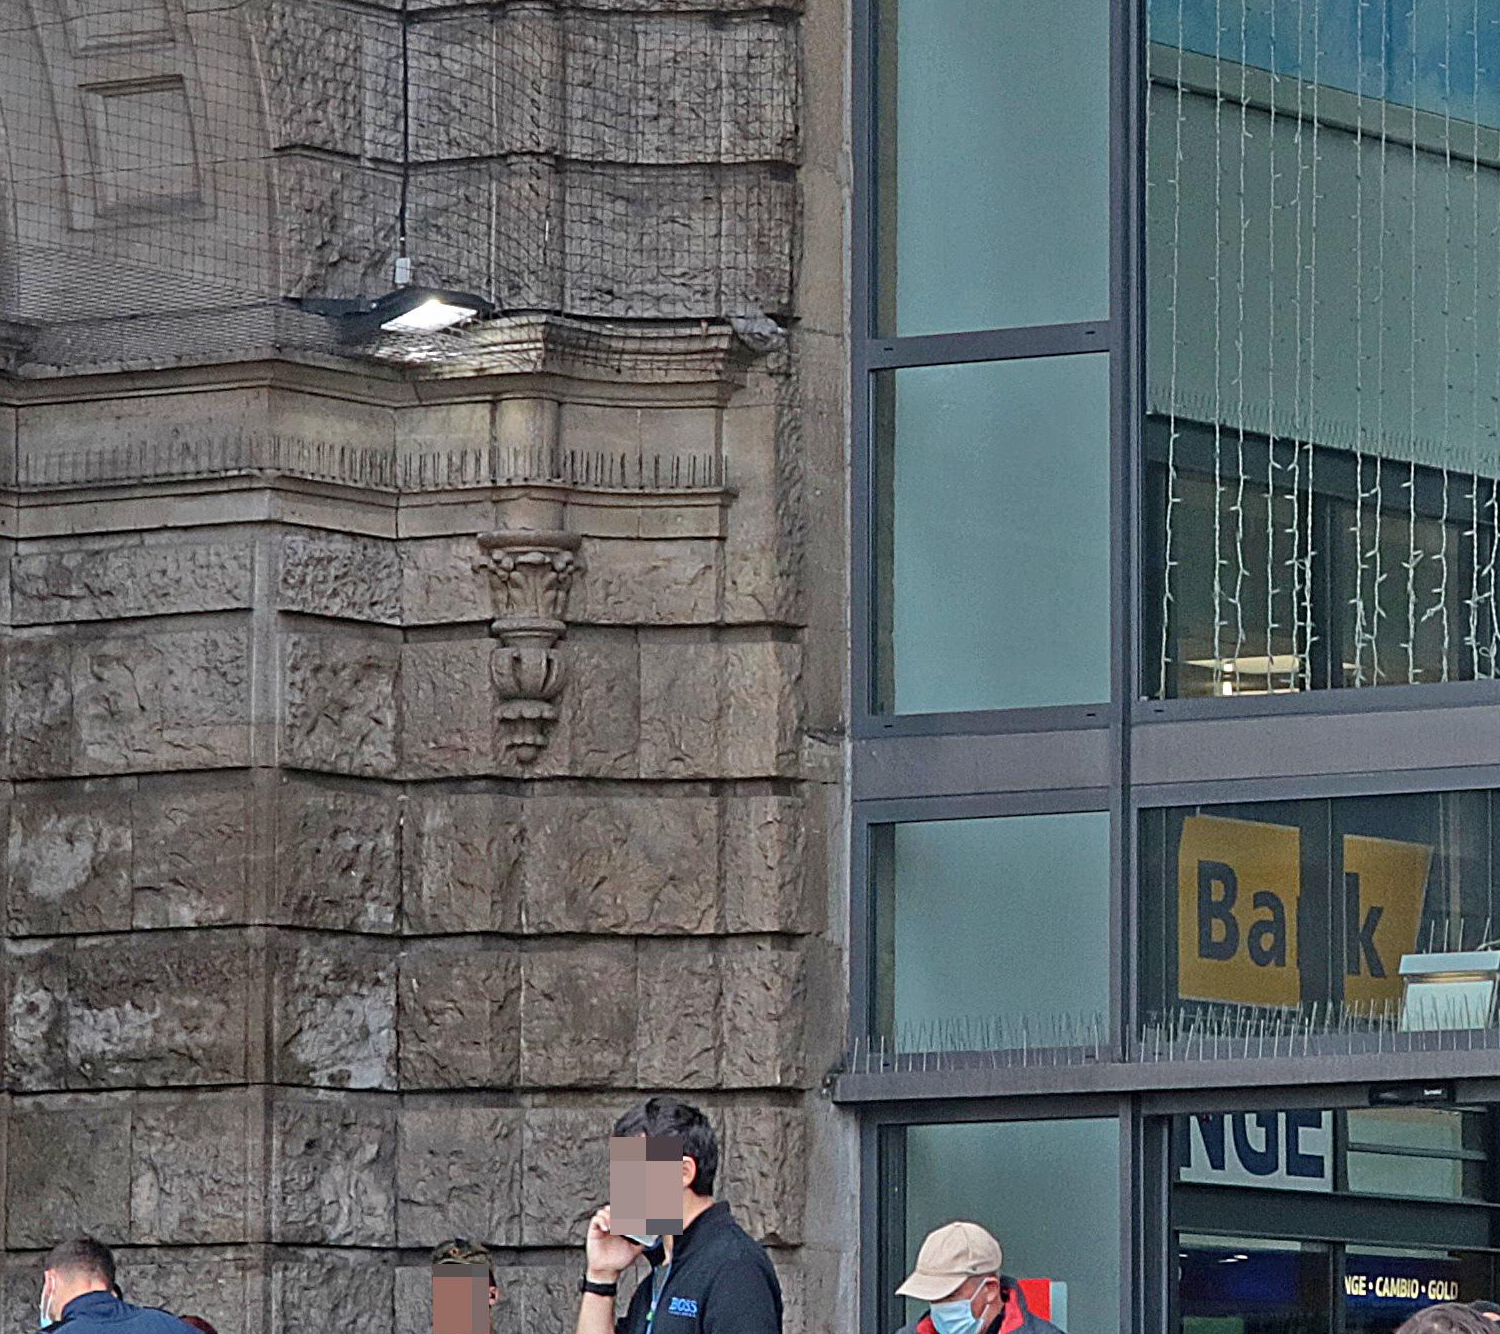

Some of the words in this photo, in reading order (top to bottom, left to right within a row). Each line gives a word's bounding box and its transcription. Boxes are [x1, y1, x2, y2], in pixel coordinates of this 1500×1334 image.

[1197, 859, 1397, 978] Bak
[1375, 1277, 1419, 1299] CAMBIO
[1427, 1281, 1459, 1300] GOLD
[669, 1297, 698, 1314] BOSS
